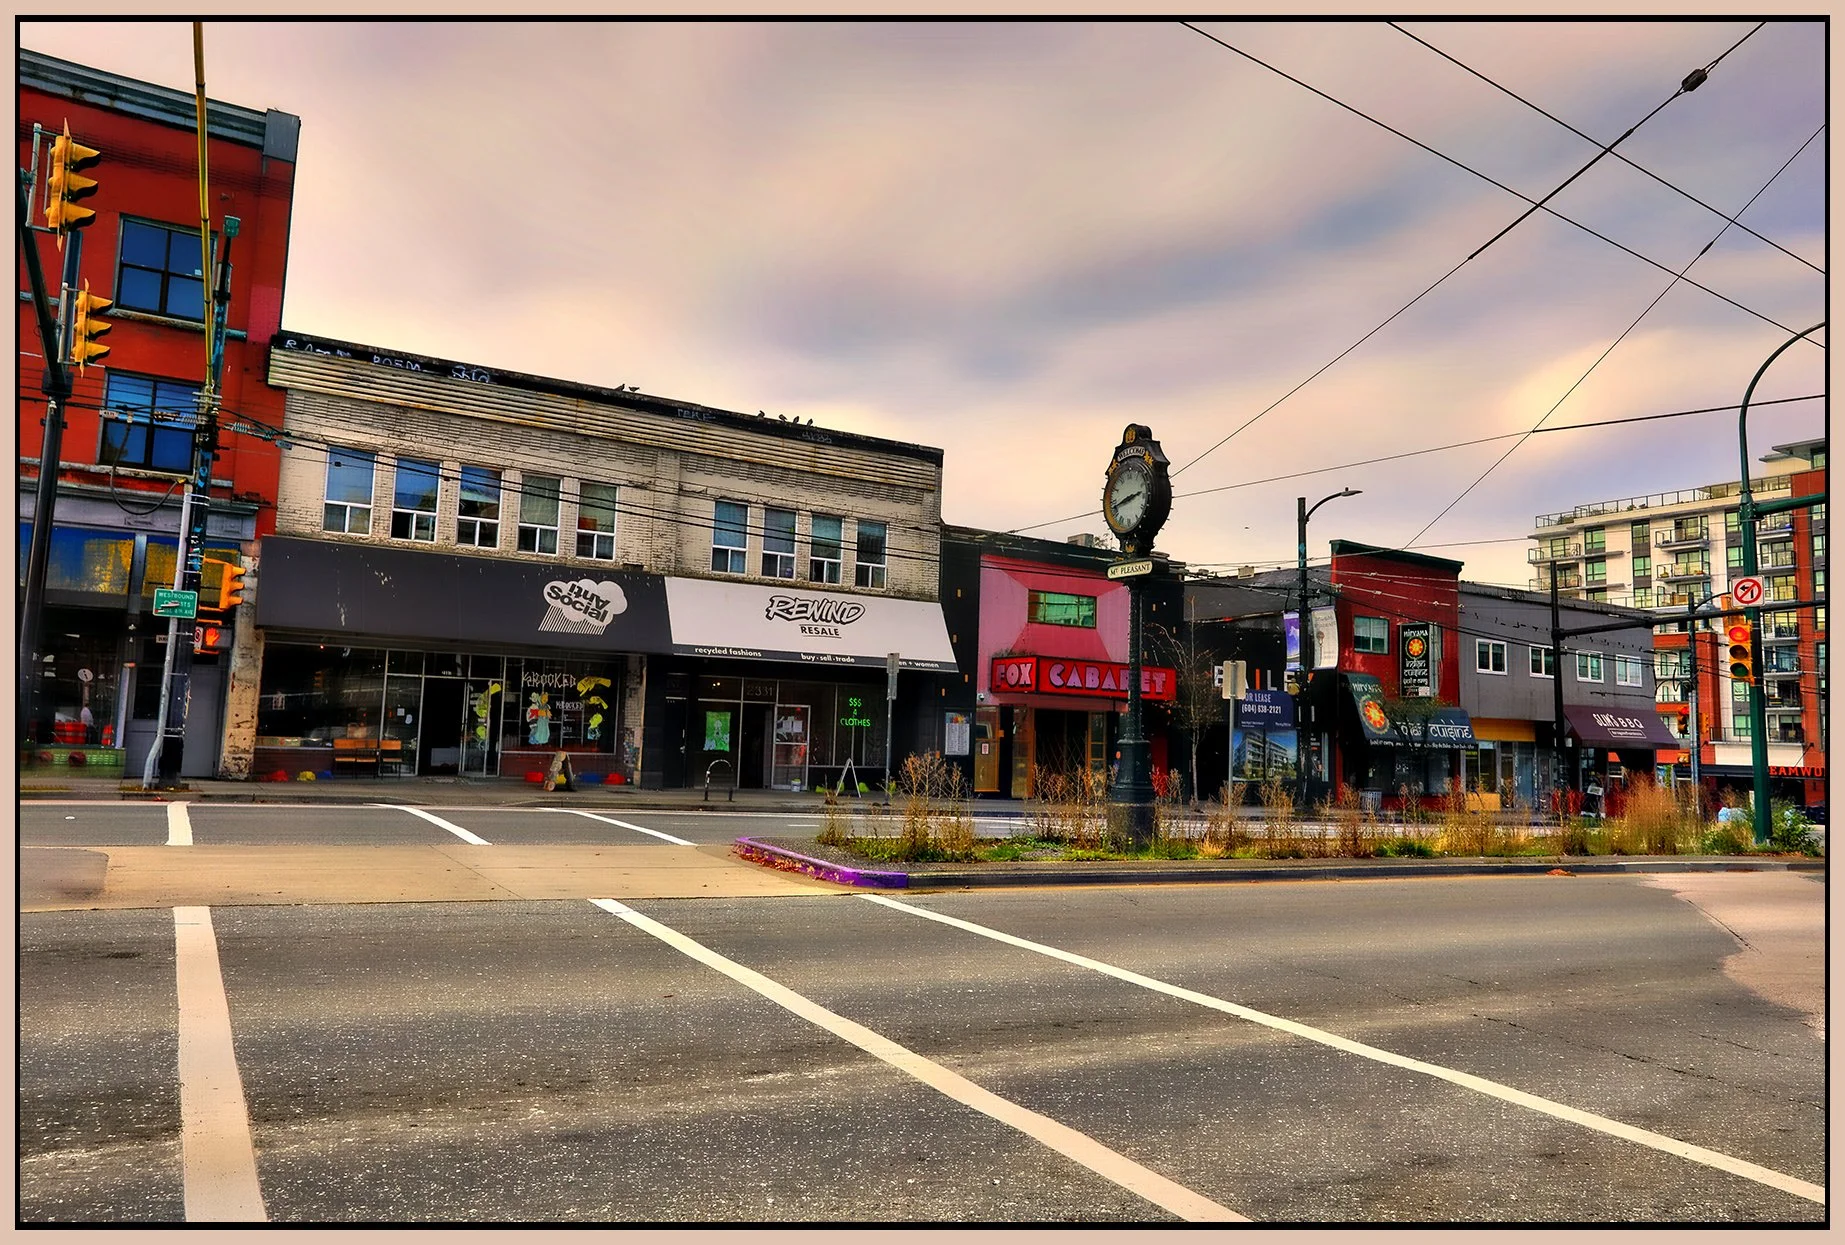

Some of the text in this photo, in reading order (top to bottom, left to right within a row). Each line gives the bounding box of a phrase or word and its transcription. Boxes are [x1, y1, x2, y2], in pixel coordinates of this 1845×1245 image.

[1121, 563, 1150, 574] PLEASANT
[158, 592, 194, 600] WESTBOUND
[568, 583, 610, 610] Anti
[547, 585, 608, 622] Social
[765, 595, 866, 625] REWIND
[800, 626, 840, 636] RESALE
[694, 647, 762, 657] recycled fashions
[801, 653, 815, 661] buy
[996, 663, 1032, 687] FOX
[1255, 693, 1271, 703] LEASE
[840, 718, 870, 727] CLOTHES
